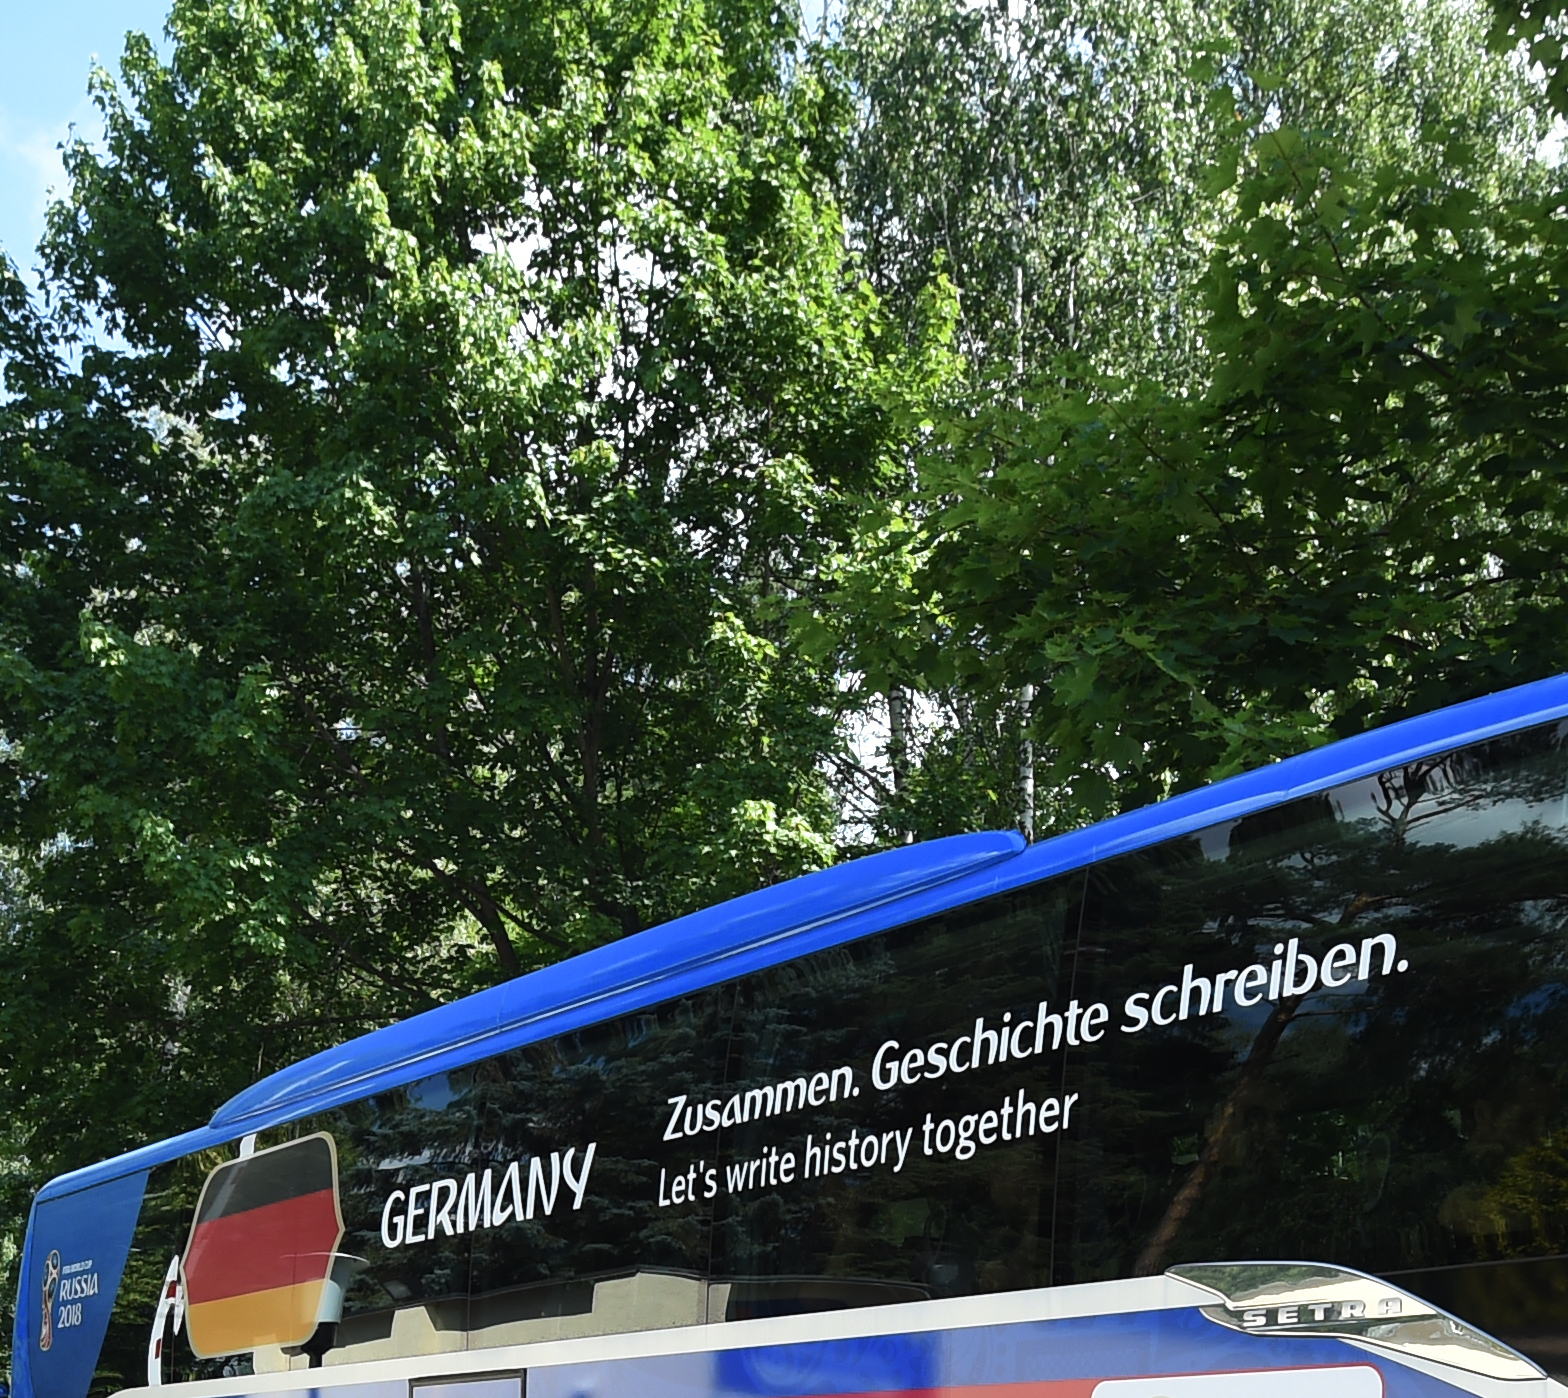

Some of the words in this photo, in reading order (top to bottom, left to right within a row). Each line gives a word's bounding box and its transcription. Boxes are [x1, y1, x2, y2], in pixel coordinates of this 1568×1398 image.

[663, 1069, 861, 1141] Zusammen.
[871, 1000, 1109, 1090] Geschichte
[1120, 932, 1409, 1036] schreiben.
[657, 1148, 718, 1207] Let's
[726, 1144, 796, 1195] write
[804, 1126, 913, 1180] history
[921, 1091, 1078, 1160] together
[381, 1142, 597, 1249] GERMANY
[57, 1303, 82, 1328] 2018
[59, 1272, 98, 1301] RUSSIA
[1242, 1297, 1403, 1328] SETRA
